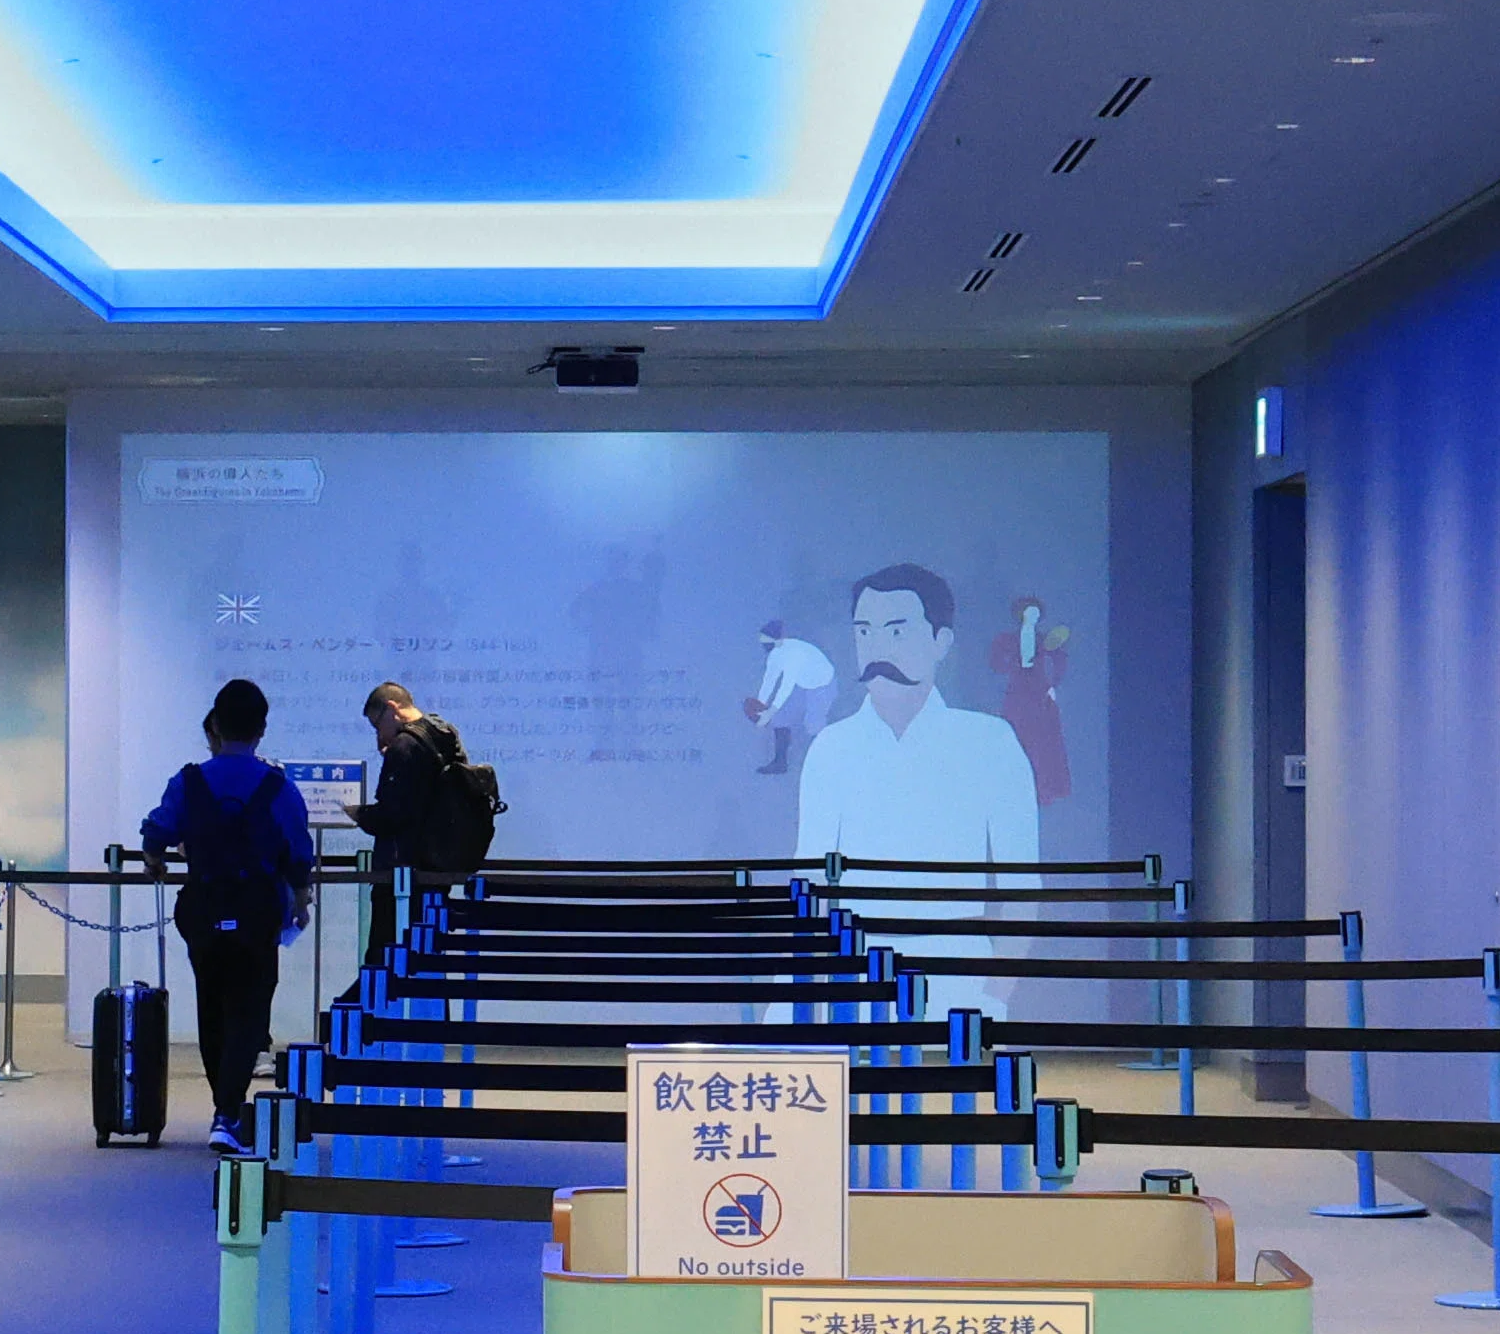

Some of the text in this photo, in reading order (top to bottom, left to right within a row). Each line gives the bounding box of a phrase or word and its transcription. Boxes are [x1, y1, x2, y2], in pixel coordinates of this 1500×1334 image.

[653, 1071, 828, 1112] 飲食持込
[693, 1121, 777, 1162] 禁止
[679, 1257, 805, 1276] No outside
